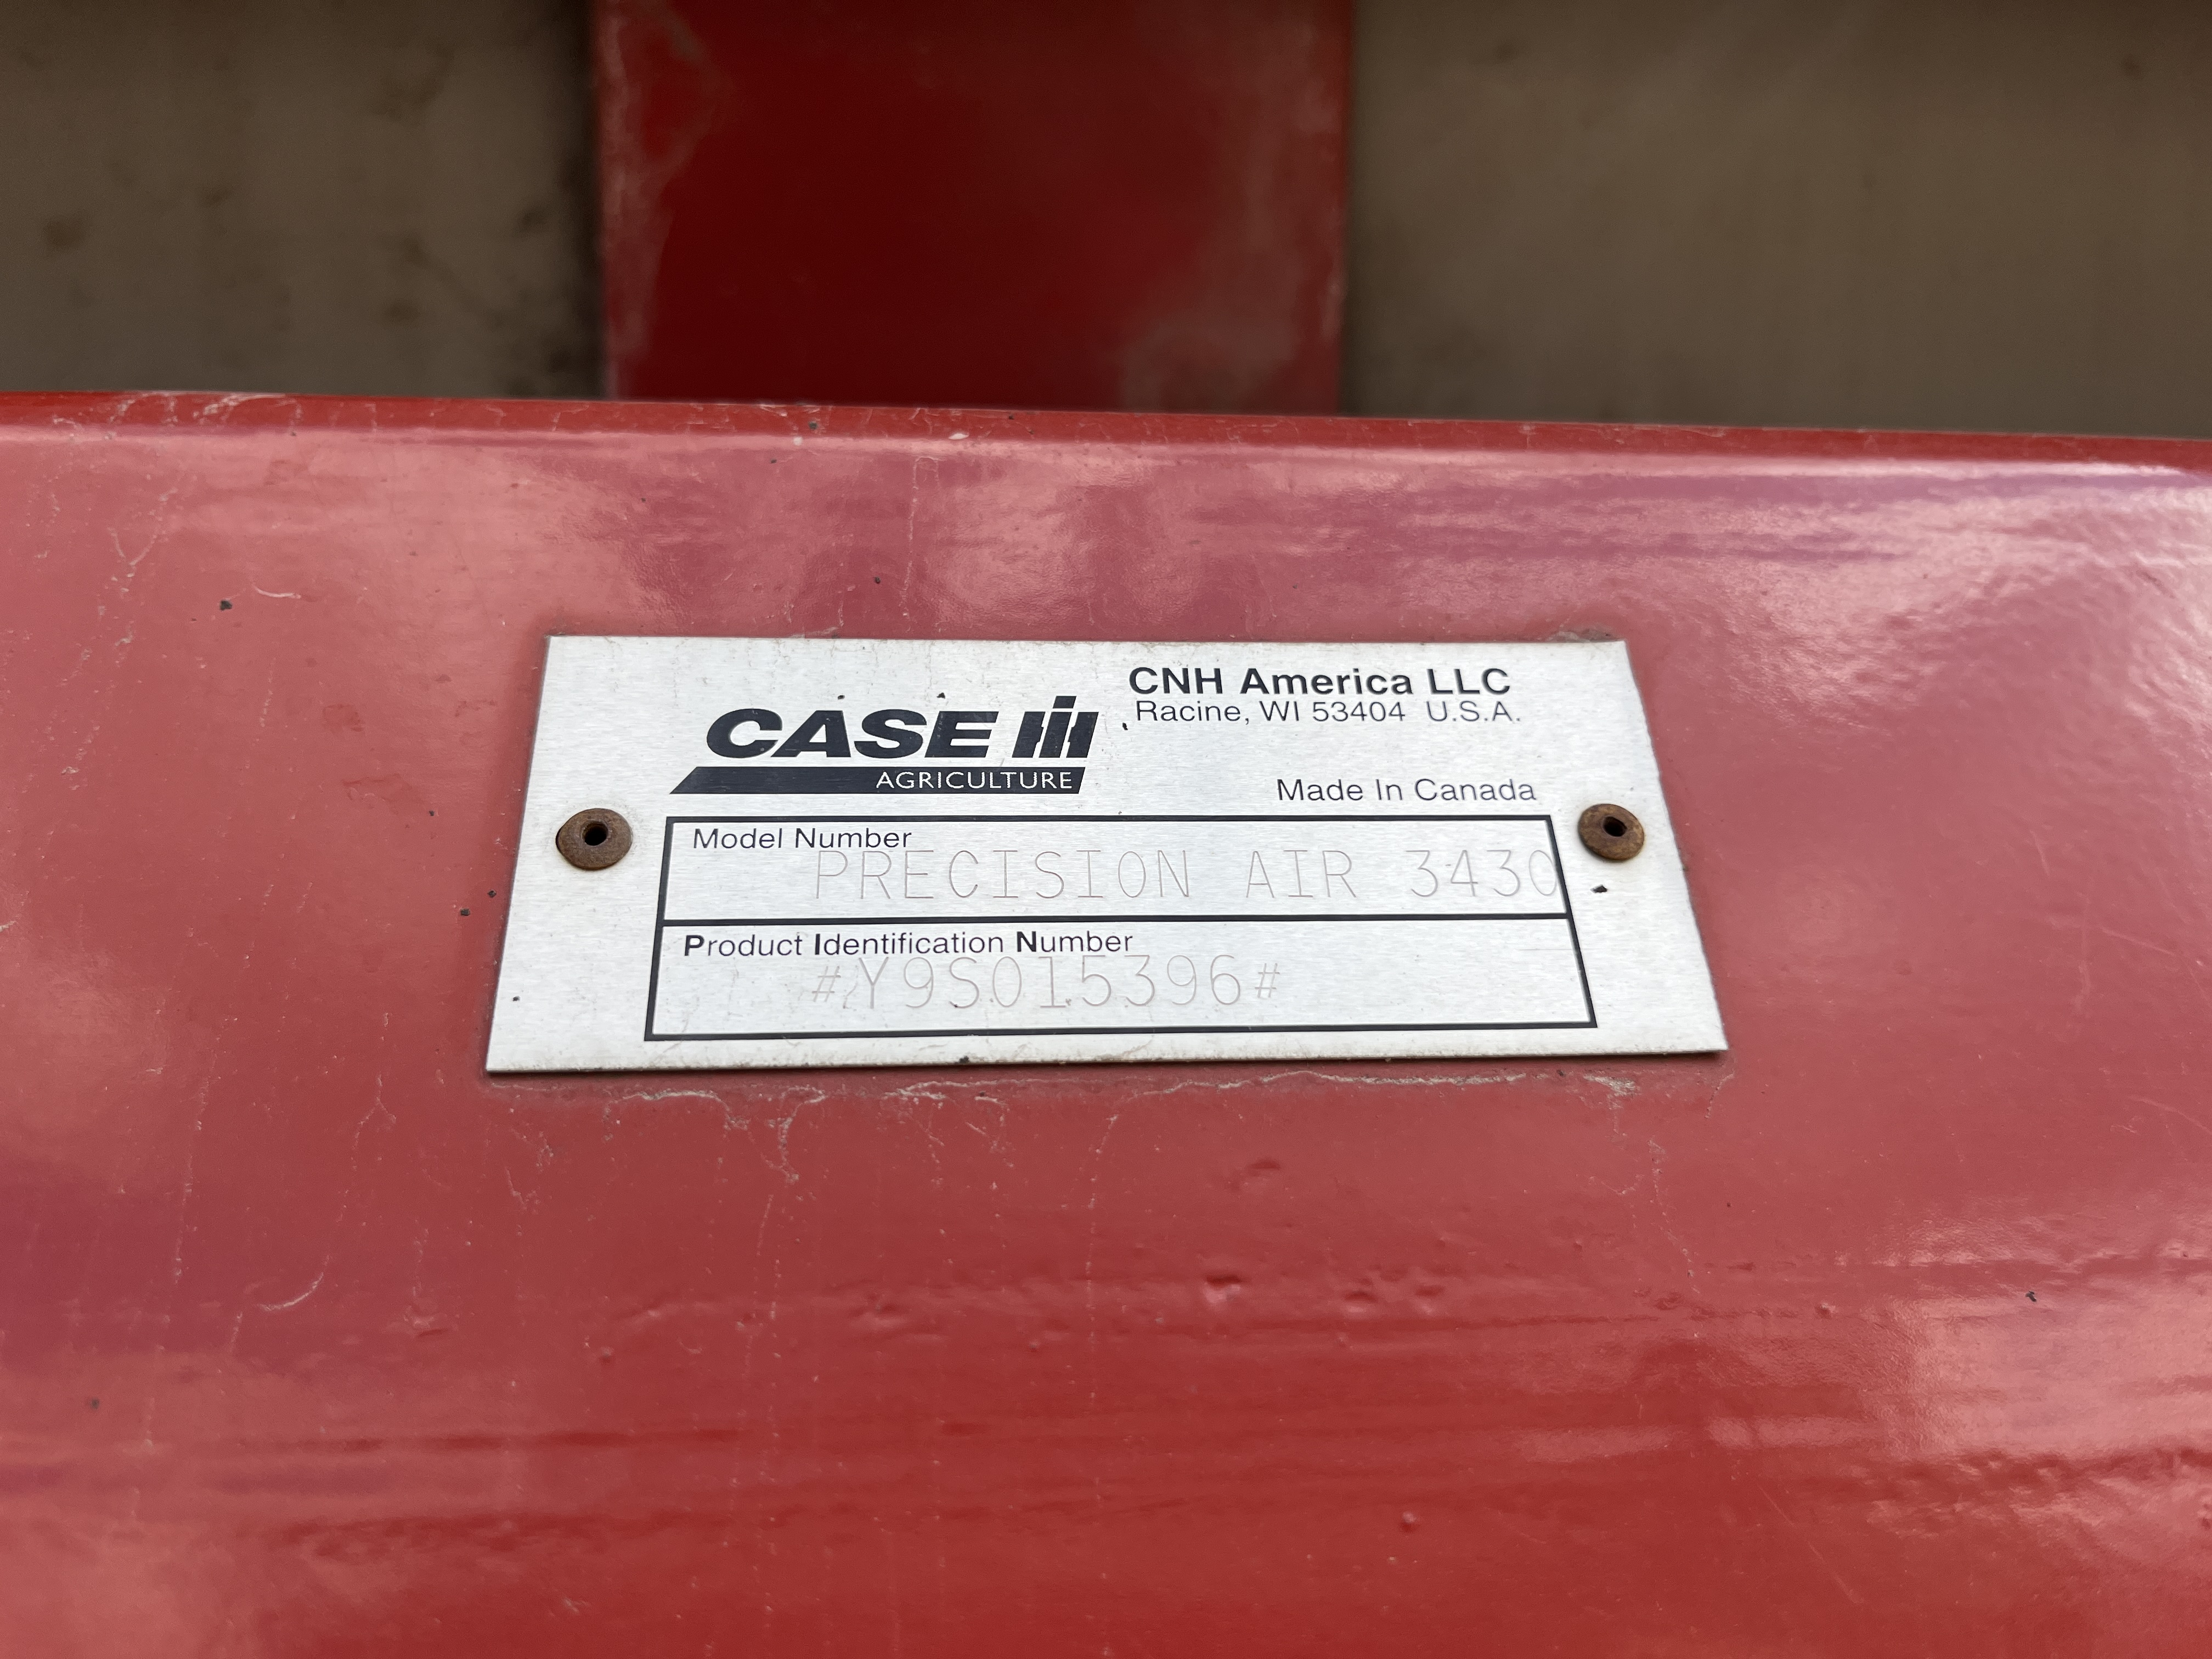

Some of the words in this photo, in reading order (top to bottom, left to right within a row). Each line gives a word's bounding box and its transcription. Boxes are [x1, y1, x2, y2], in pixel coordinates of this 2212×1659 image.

[1129, 667, 1223, 695] CNH
[1240, 668, 1414, 695] America
[1428, 668, 1511, 695] LLC
[1136, 700, 1250, 725] Racine,
[1262, 701, 1299, 722] WI
[1312, 701, 1406, 723] 53404
[1427, 701, 1521, 723] U.S.A.
[707, 708, 998, 758] CASE
[876, 771, 1073, 790] AGRICULTURE
[1277, 778, 1363, 801] Made
[1377, 778, 1403, 801] In
[1414, 778, 1536, 801] Canada
[693, 827, 782, 849] Model
[795, 827, 912, 849] Number
[816, 850, 1190, 900] PRECISION
[1246, 850, 1357, 899] AIR
[1406, 850, 1559, 898] 3430
[684, 933, 802, 957] Product
[814, 932, 1003, 956] Identification
[1017, 930, 1133, 953] Number
